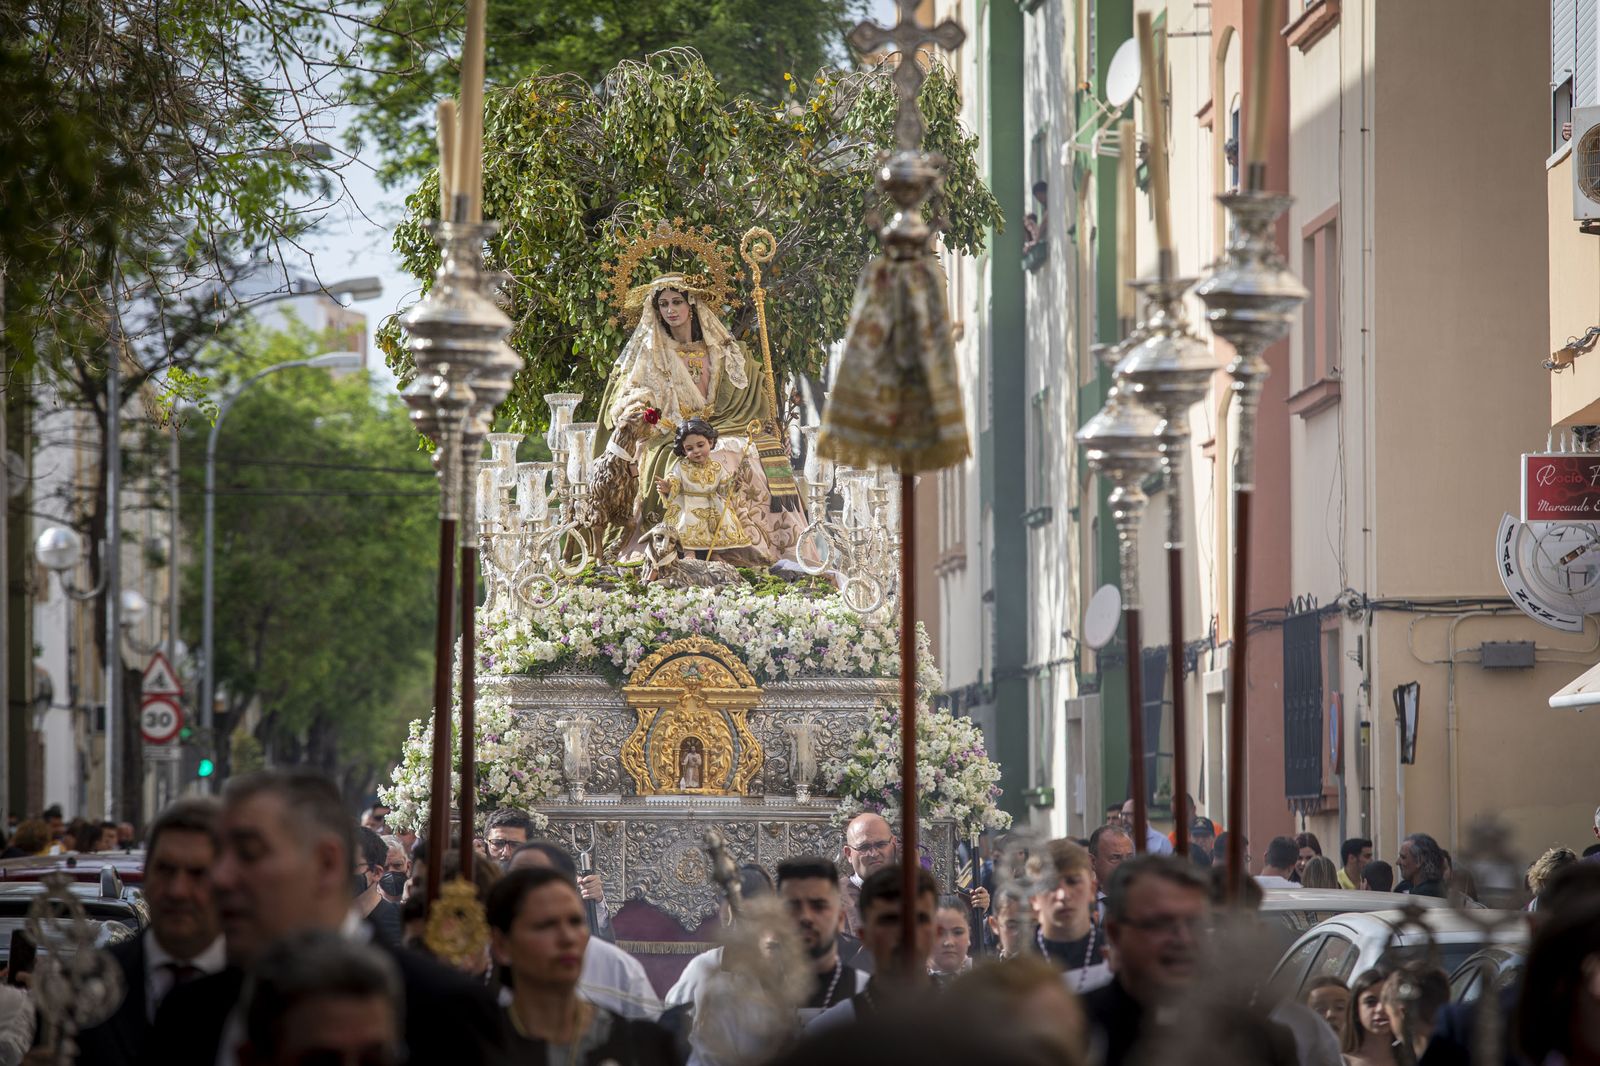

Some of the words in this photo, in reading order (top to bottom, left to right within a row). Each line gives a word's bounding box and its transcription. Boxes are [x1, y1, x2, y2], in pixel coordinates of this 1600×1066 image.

[1537, 497, 1590, 512] Marcando
[1503, 524, 1515, 577] BAR
[146, 711, 172, 728] 30
